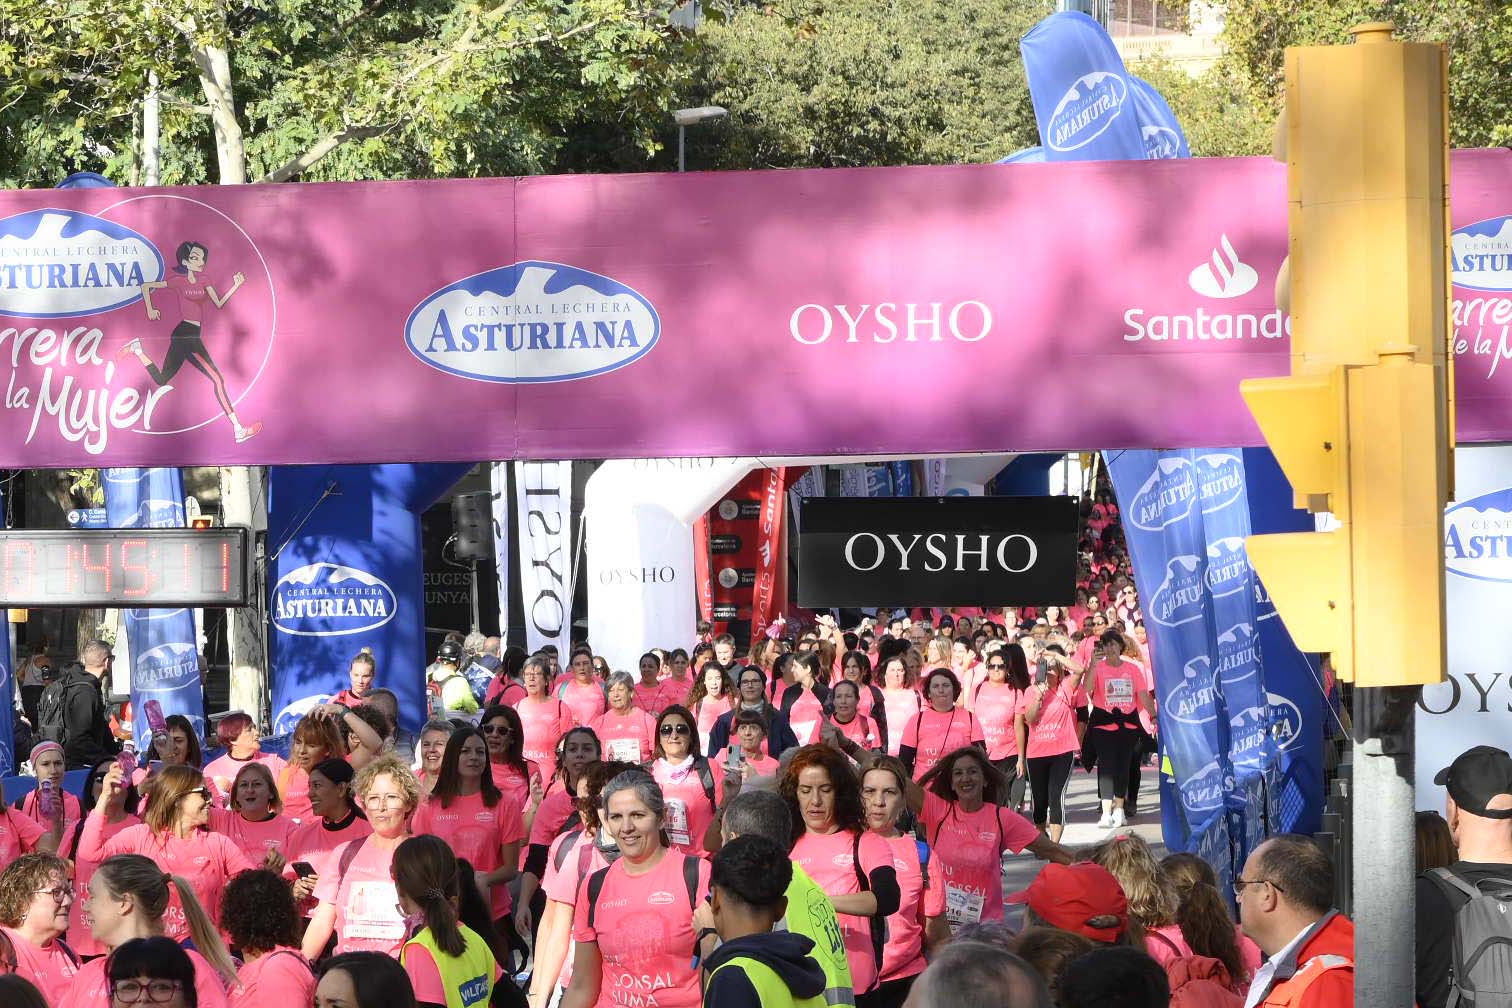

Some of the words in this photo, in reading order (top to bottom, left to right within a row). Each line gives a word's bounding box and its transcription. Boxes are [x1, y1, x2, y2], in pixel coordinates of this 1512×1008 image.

[65, 244, 140, 257] LECHERA
[464, 304, 543, 318] CENTRAL
[551, 302, 633, 315] LECHERA
[790, 300, 994, 345] OYSHO
[425, 308, 641, 354] ASTURIANA
[1474, 326, 1492, 355] la
[5, 370, 30, 410] la
[24, 360, 175, 455] Mujer
[844, 532, 1039, 573] OYSHO
[598, 565, 676, 586] OYSHO
[275, 592, 388, 620] ASTURIANA
[287, 588, 331, 597] CENTRAL
[334, 587, 383, 596] LECHERA
